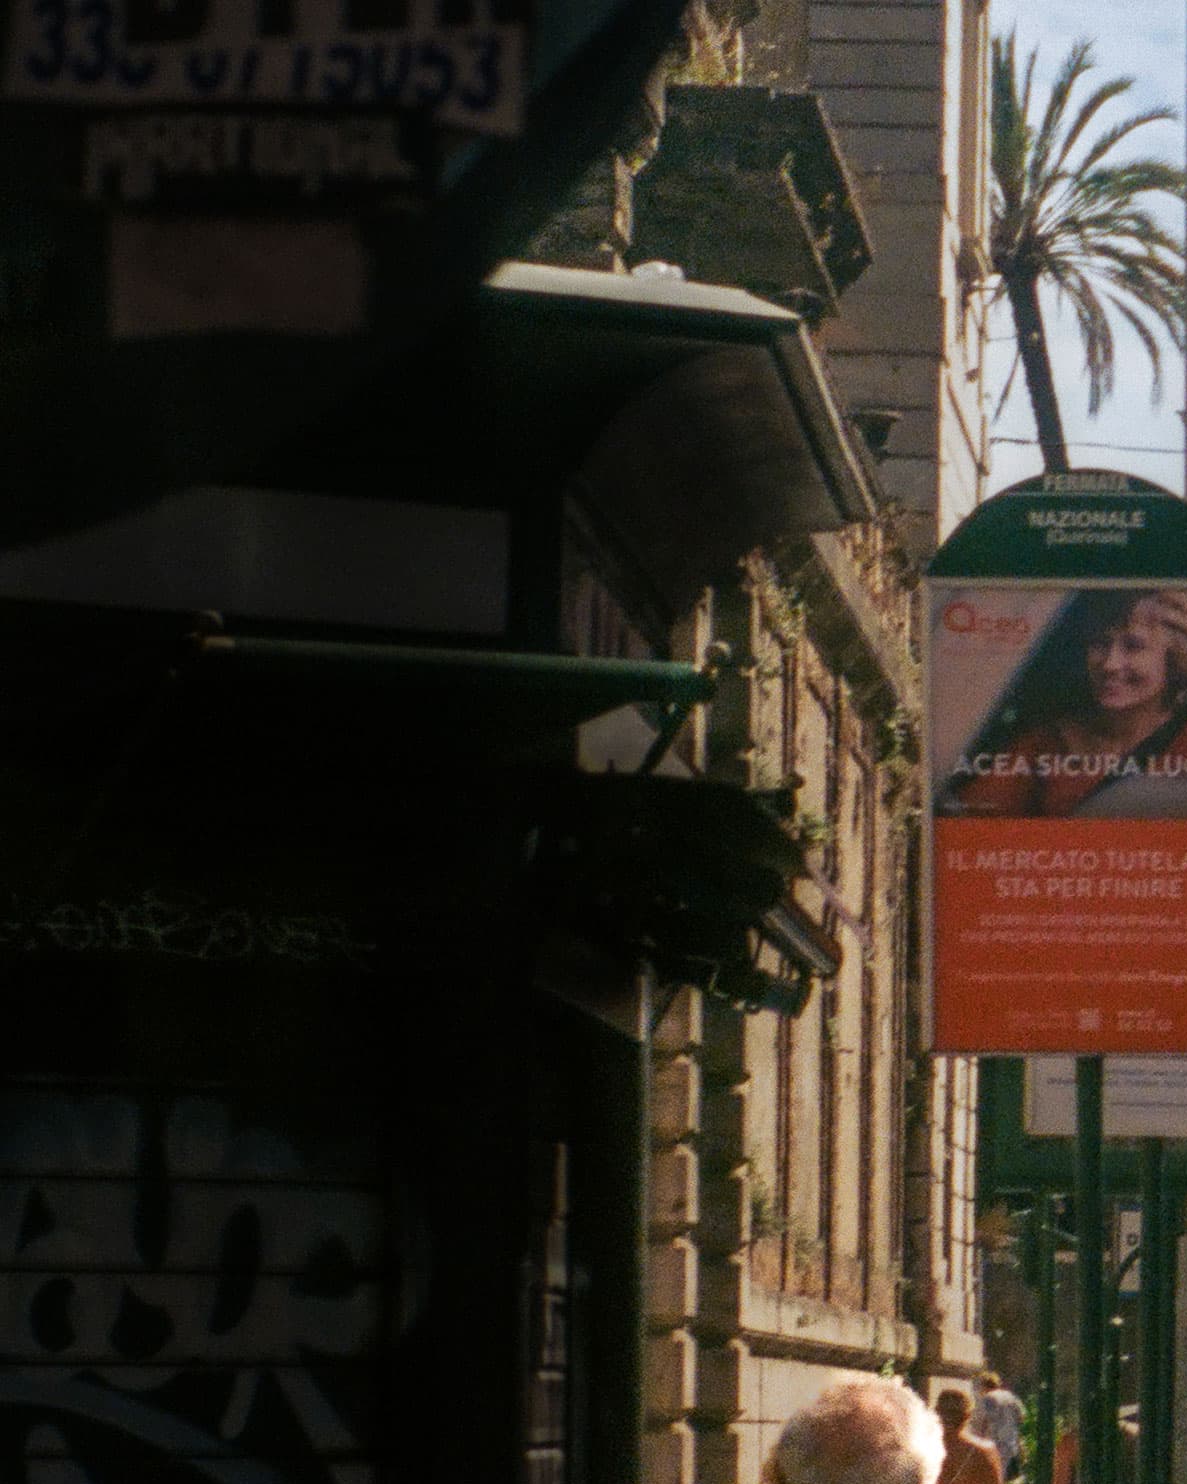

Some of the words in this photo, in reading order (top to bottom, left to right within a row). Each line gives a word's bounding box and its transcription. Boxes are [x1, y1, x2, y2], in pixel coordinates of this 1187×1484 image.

[1043, 473, 1130, 491] FERMATA
[1028, 509, 1146, 528] NAZIONALE
[953, 753, 1031, 776] ACEA
[1036, 753, 1144, 777] SICURA
[947, 849, 970, 870] IL
[976, 849, 1100, 871] MERCATO
[996, 877, 1040, 898] STA
[1046, 877, 1093, 898] PER
[1098, 877, 1184, 898] FINIRE
